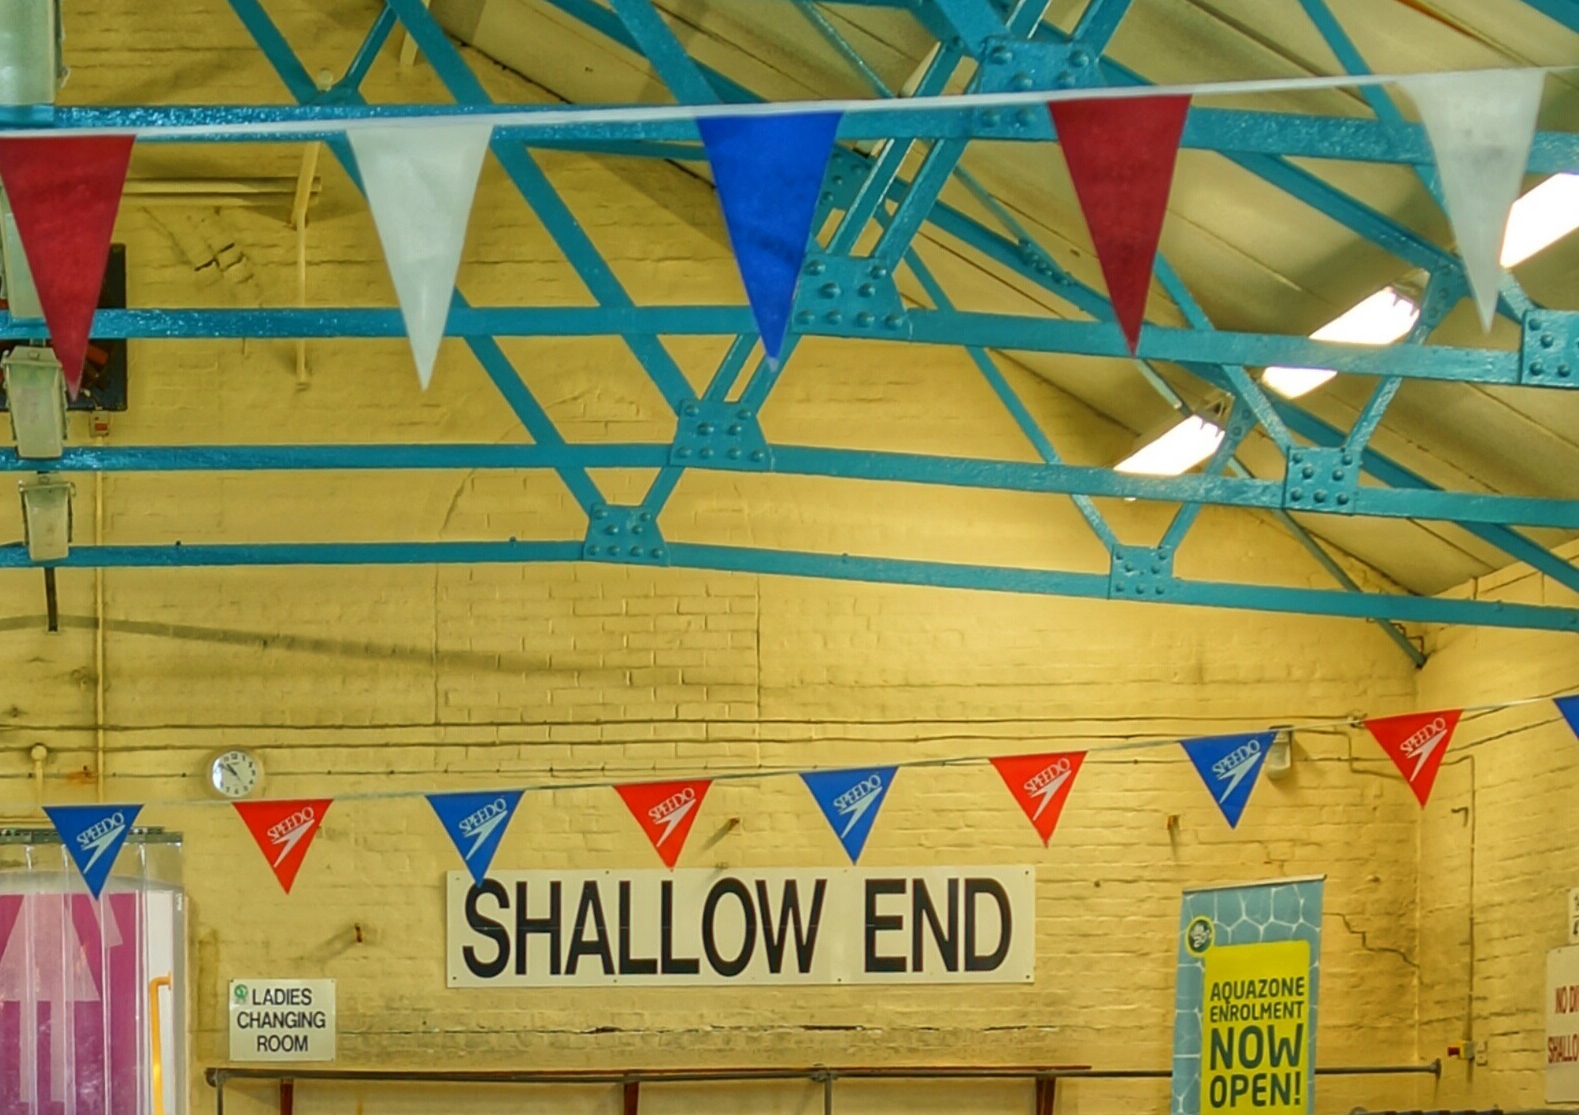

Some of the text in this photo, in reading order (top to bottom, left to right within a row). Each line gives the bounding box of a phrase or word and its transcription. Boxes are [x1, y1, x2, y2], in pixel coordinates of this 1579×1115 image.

[1400, 717, 1446, 752] SPEEDO
[1212, 740, 1260, 775] SPEEDO
[833, 775, 881, 810] SPEEDO
[1024, 758, 1070, 793] SPEEDO
[459, 798, 507, 832] SPEEDO
[648, 788, 695, 820] SPEEDO
[76, 812, 124, 846] SPEEDO
[267, 807, 314, 841] SPEEDO
[462, 877, 1013, 978] SHALLOW END
[252, 988, 312, 1006] LADIES
[1210, 976, 1305, 1004] AQUAZONE
[237, 1011, 326, 1029] CHANGING
[1210, 1001, 1305, 1023] ENROLMENT
[256, 1034, 309, 1052] ROOM
[1210, 1023, 1304, 1070] NOW
[1547, 1034, 1579, 1064] SHALLO
[1209, 1071, 1302, 1108] OPEN!
